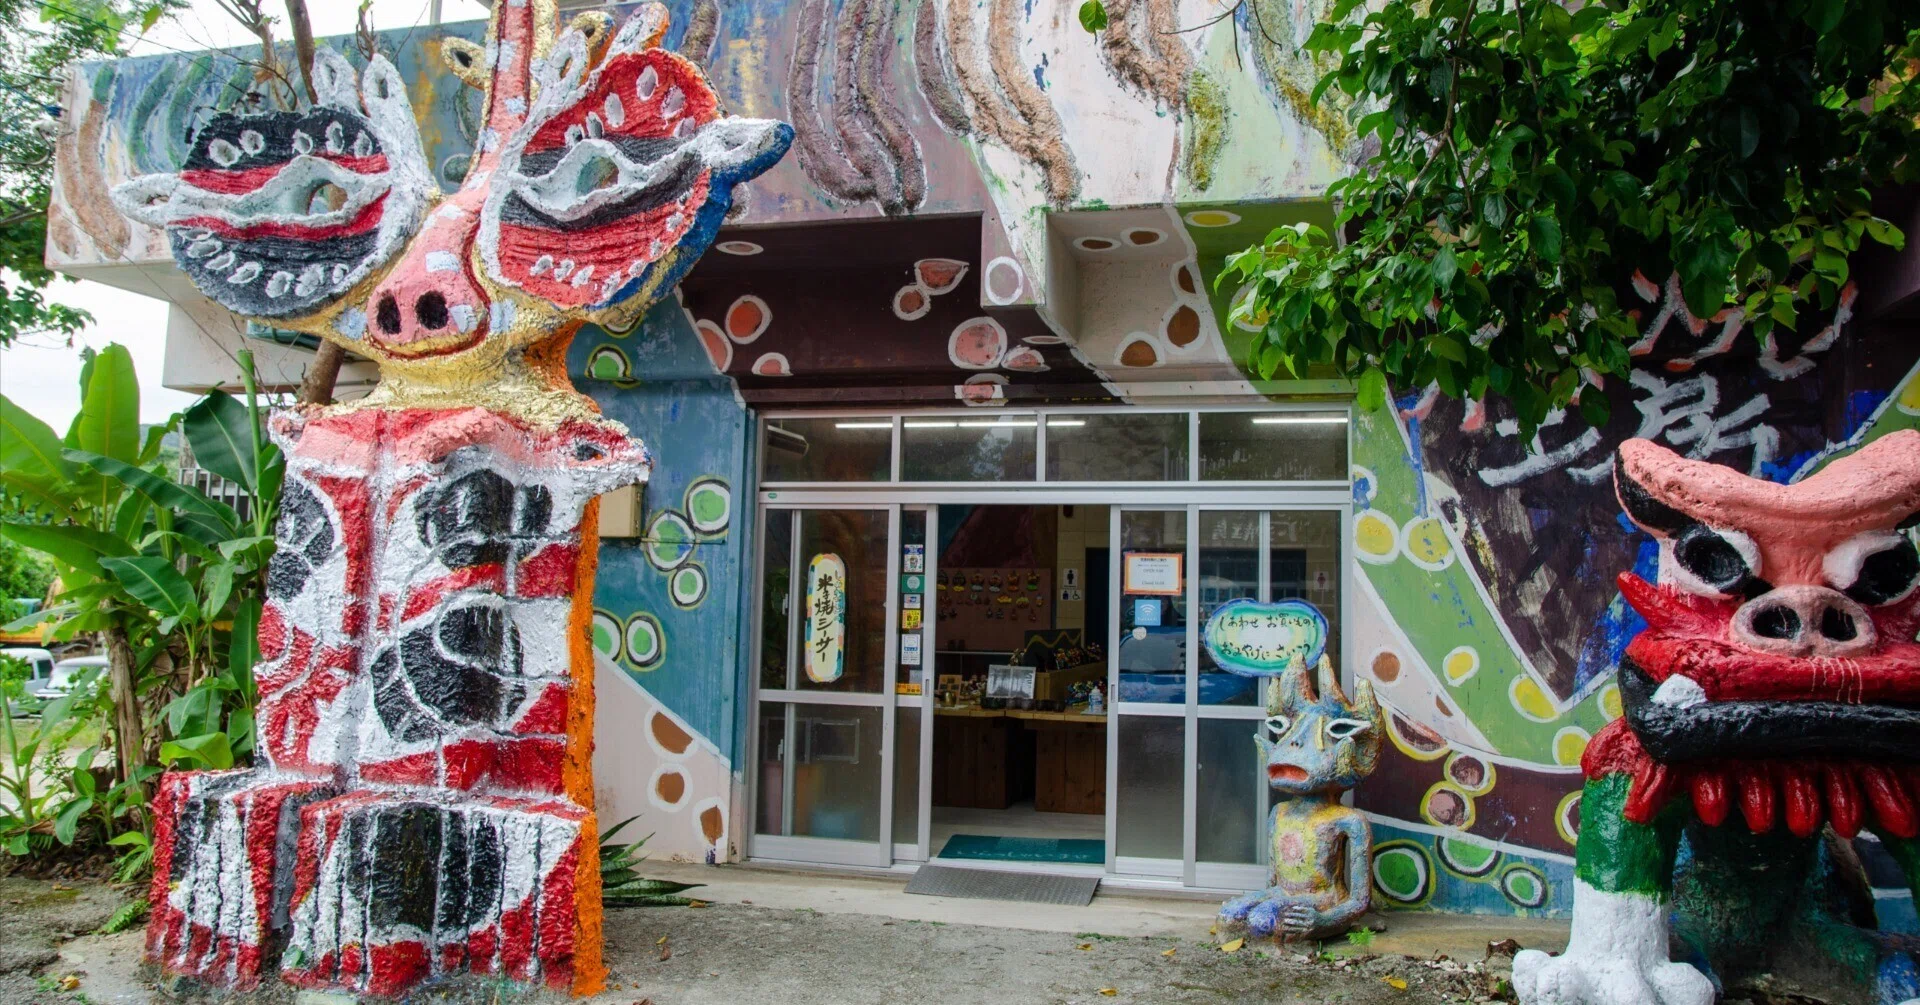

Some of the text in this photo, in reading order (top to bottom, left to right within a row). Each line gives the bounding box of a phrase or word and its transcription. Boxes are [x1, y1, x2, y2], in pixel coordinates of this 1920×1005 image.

[814, 573, 834, 662] 米子焼シーサー
[1220, 616, 1259, 631] しあわせ
[1221, 642, 1270, 660] おみやげに
